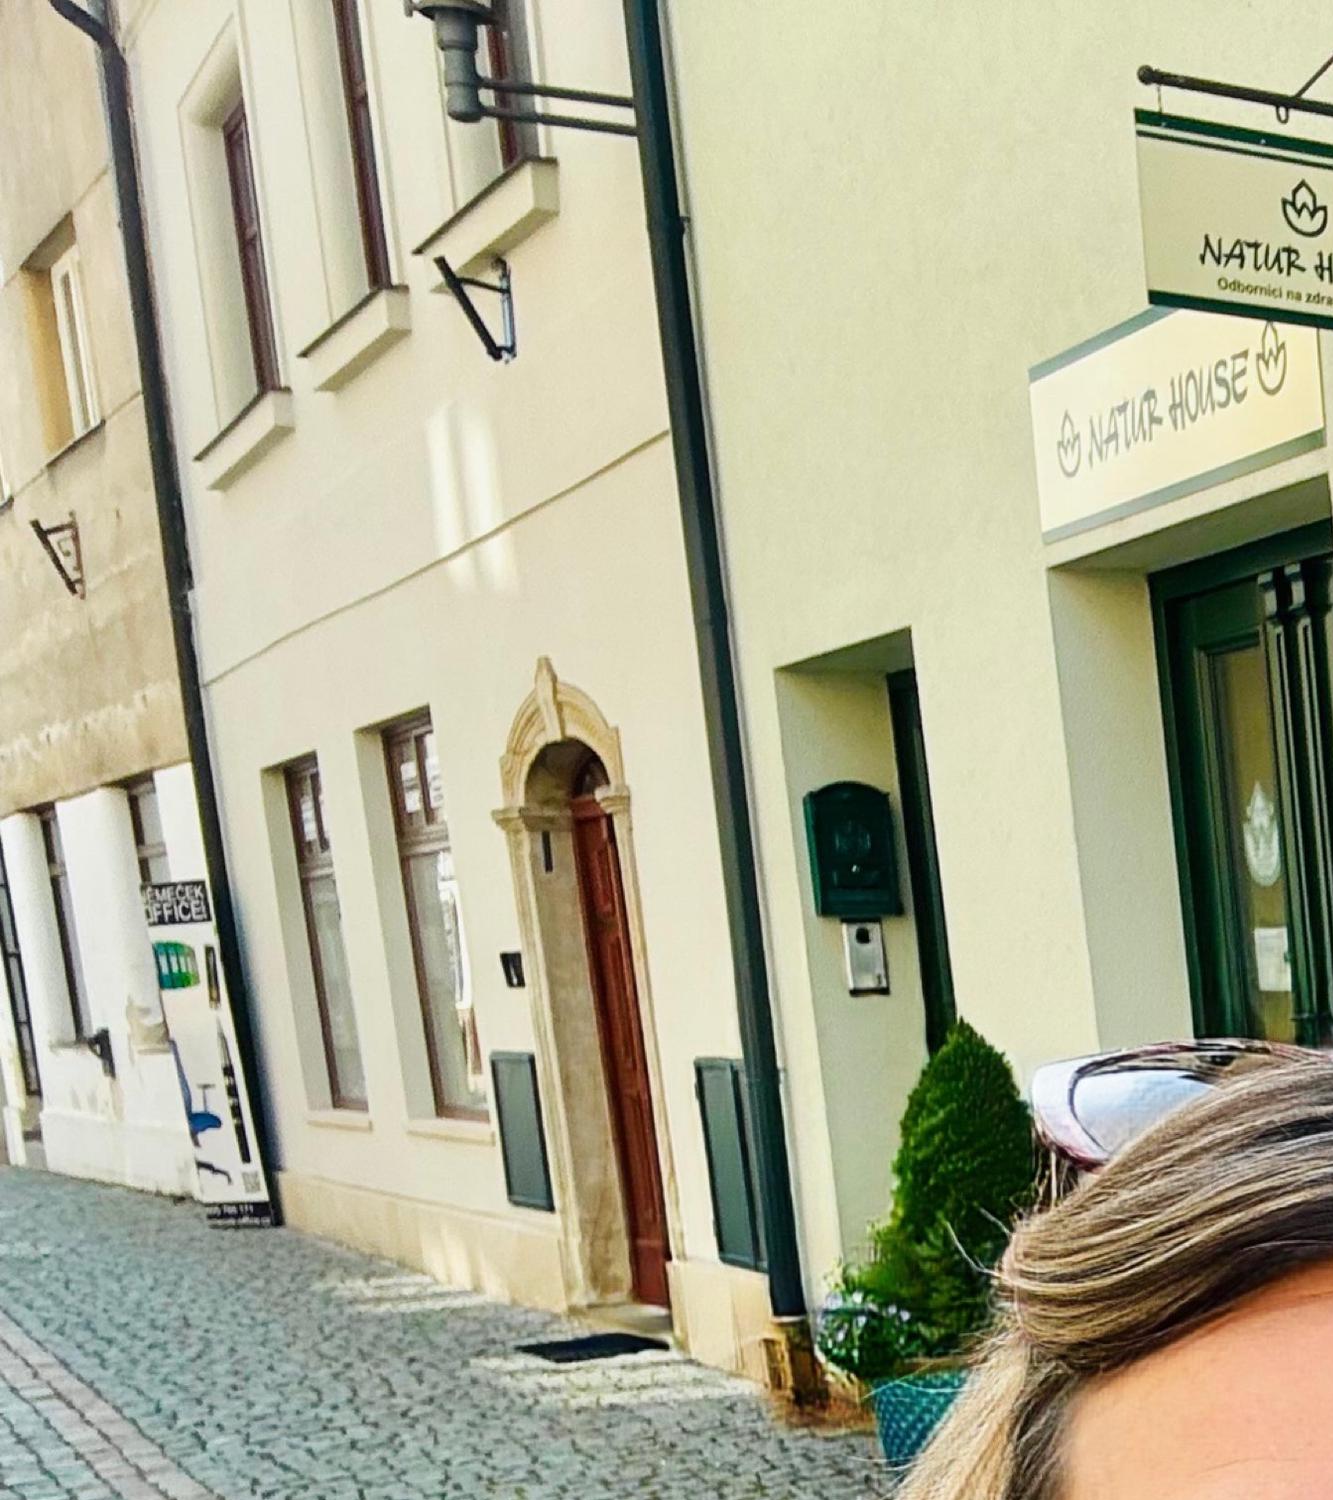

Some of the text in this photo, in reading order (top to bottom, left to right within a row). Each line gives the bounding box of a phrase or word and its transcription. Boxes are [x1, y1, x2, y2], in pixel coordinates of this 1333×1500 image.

[1199, 234, 1306, 277] NATUR
[1286, 290, 1302, 301] na
[1088, 348, 1250, 468] NATUR HOUSE
